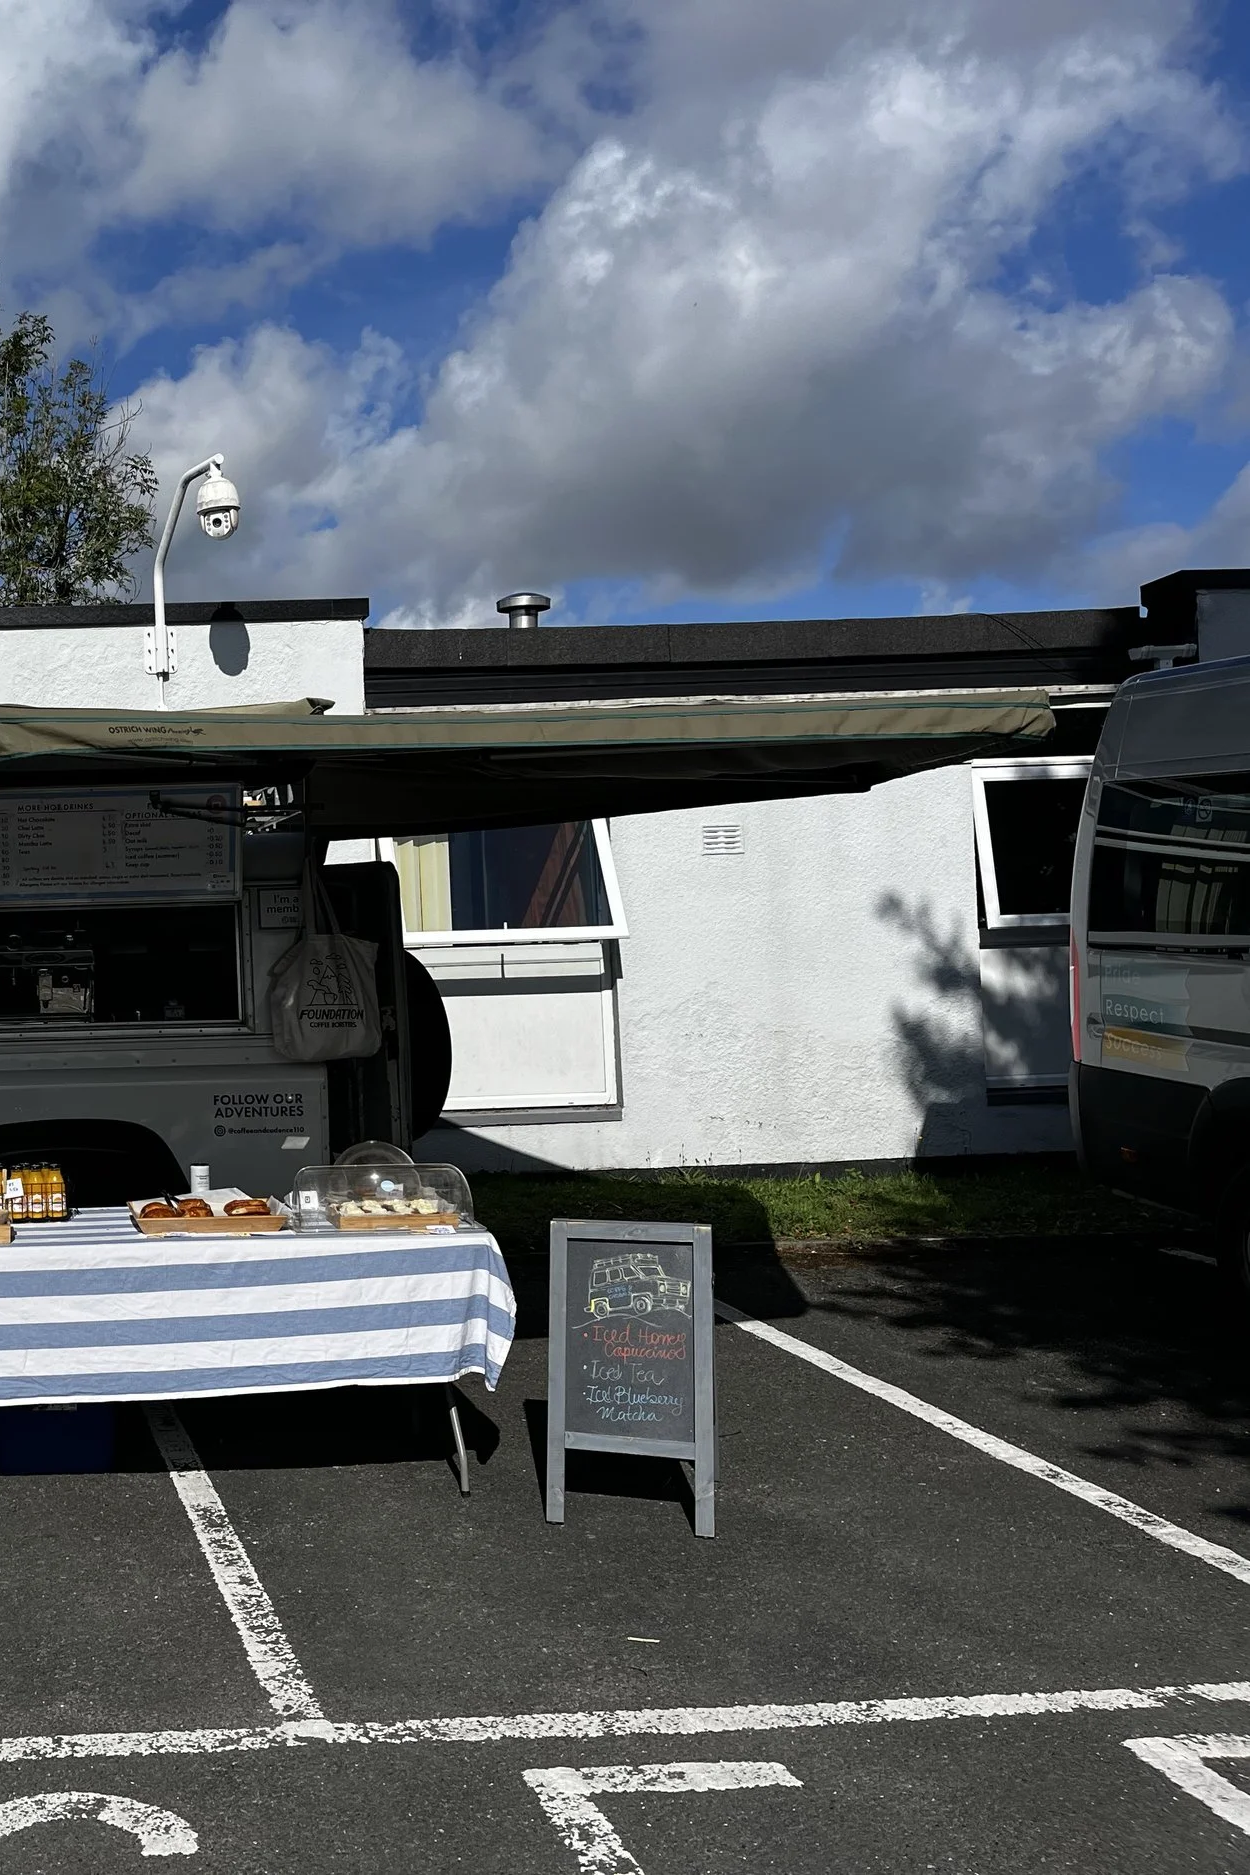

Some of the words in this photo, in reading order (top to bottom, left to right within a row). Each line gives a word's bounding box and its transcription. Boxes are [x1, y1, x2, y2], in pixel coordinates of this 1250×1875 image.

[108, 726, 142, 735] OSTRICH
[143, 727, 166, 735] WING
[17, 804, 41, 812] MORE
[62, 802, 95, 811] DRINKS
[273, 894, 290, 904] I'm
[299, 1009, 364, 1021] FOUNDATION
[1105, 999, 1165, 1026] Respect
[1105, 1033, 1163, 1060] Success
[213, 1094, 269, 1106] FOLLOW
[273, 1093, 303, 1104] OUR
[214, 1105, 304, 1119] ADVENTURES
[592, 1323, 634, 1346] Iced
[638, 1328, 688, 1346] Honey
[589, 1360, 624, 1381] Iced
[629, 1363, 665, 1386] Tea
[613, 1385, 684, 1416] Blueberry
[596, 1409, 664, 1422] Matcha
